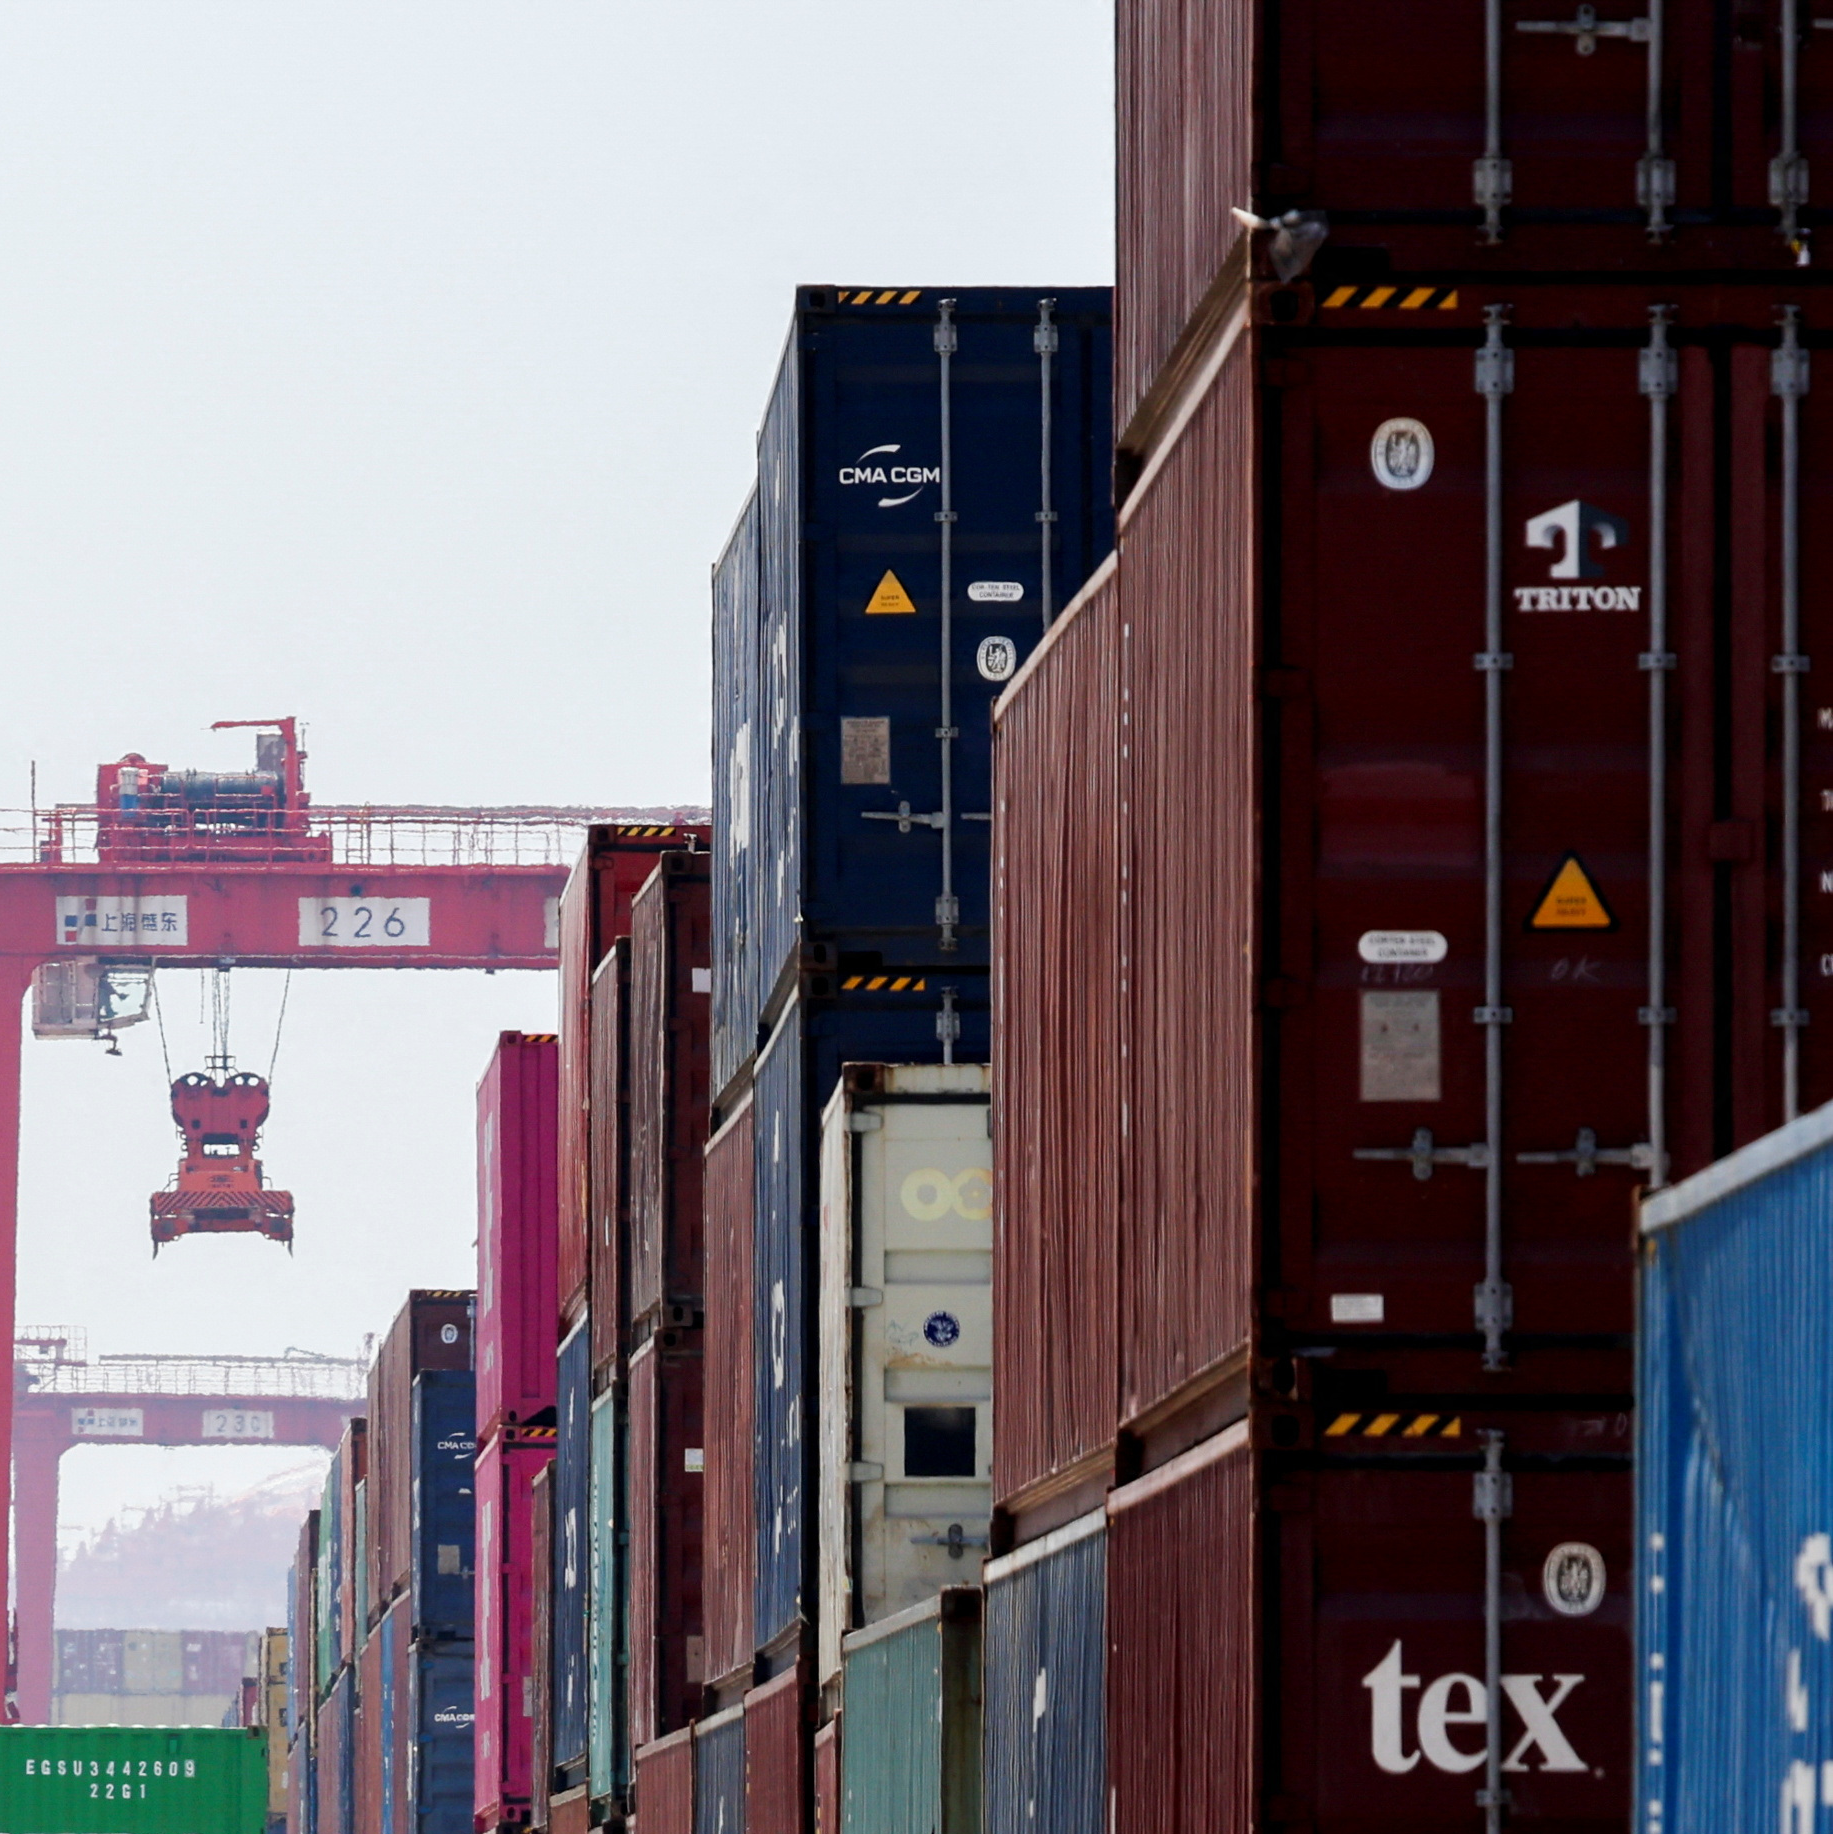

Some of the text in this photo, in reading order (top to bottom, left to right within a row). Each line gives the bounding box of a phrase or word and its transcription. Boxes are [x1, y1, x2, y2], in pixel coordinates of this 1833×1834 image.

[839, 466, 941, 484] CMA CGM
[1515, 586, 1641, 612] TRITON
[320, 907, 406, 938] 226
[1361, 1640, 1589, 1775] tex
[90, 1783, 146, 1799] 22G1
